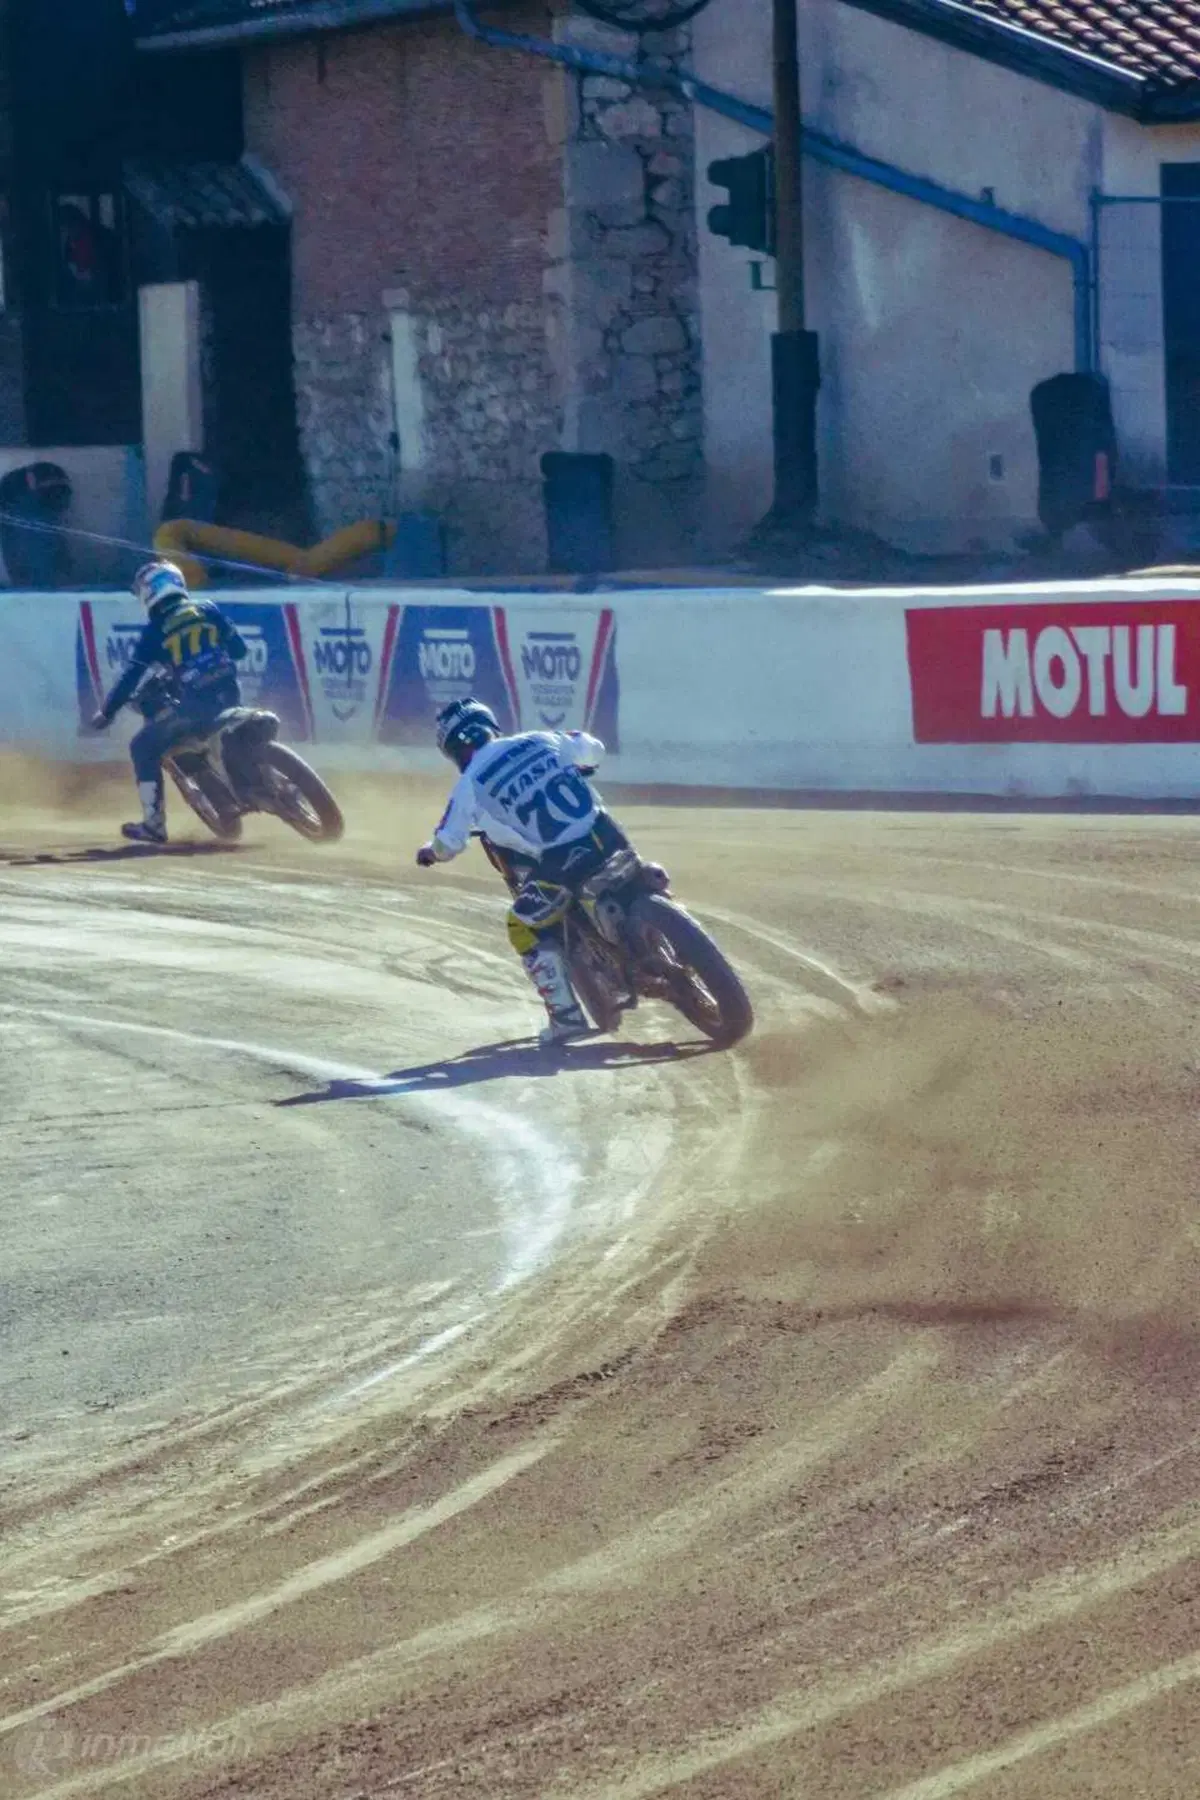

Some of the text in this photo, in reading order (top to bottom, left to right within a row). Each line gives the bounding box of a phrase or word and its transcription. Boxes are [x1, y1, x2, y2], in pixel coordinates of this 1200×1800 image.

[313, 640, 373, 675] MOTO
[418, 642, 476, 678] MOTO
[520, 644, 582, 681] MOTO
[980, 624, 1187, 718] MOTUL
[515, 771, 594, 842] 70
